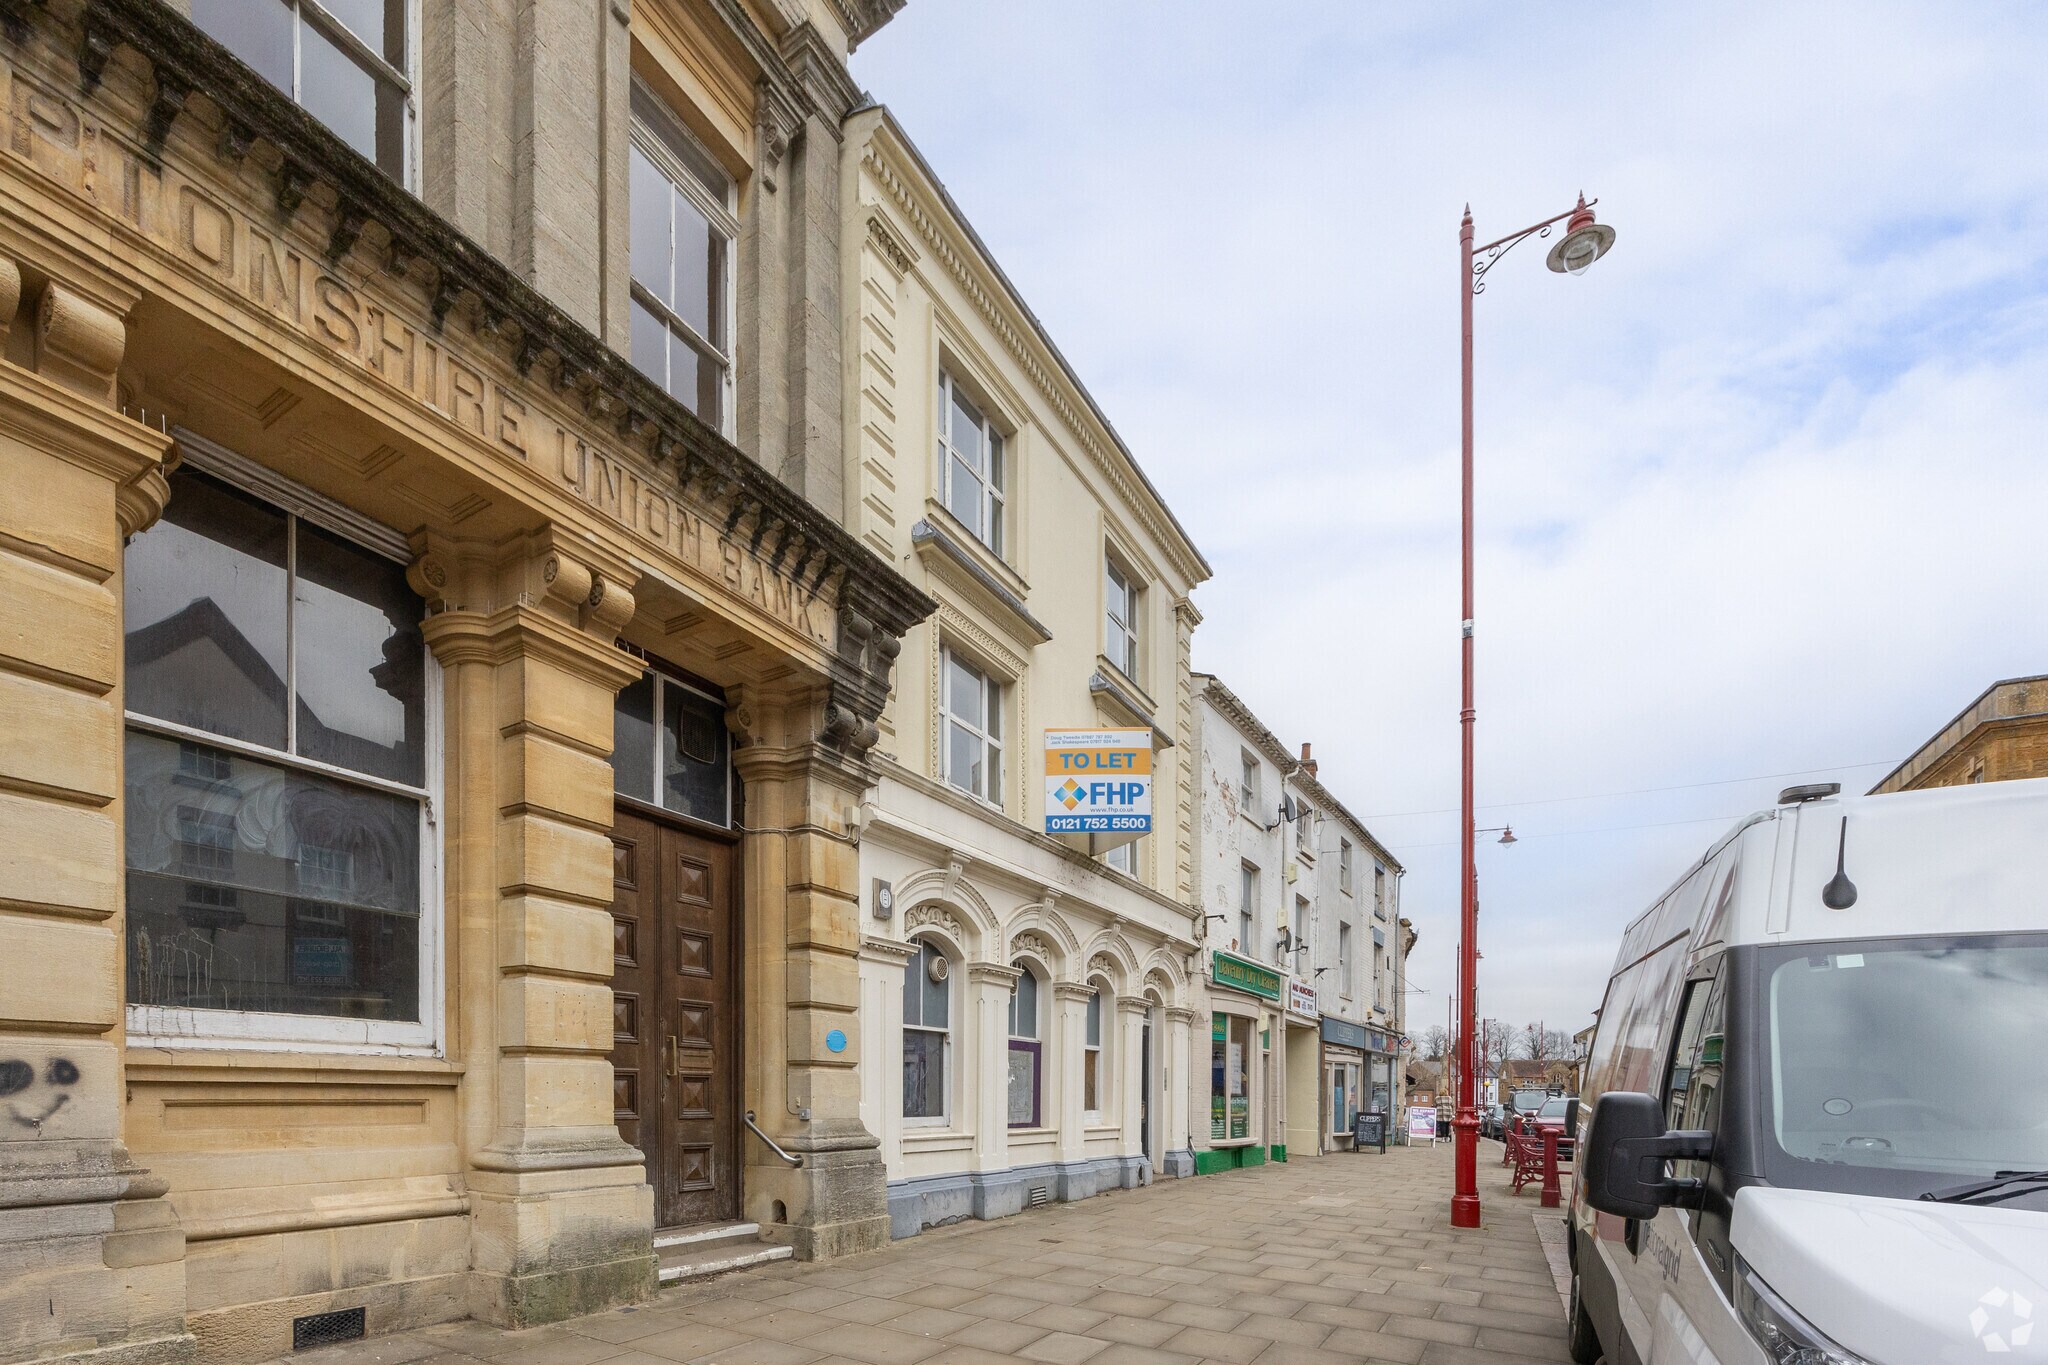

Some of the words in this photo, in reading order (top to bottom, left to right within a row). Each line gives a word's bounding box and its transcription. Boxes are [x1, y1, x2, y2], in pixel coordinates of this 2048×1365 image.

[555, 426, 702, 560] UNION
[1059, 753, 1090, 769] TO
[1095, 752, 1137, 769] LET
[1090, 782, 1145, 805] FHP
[1051, 818, 1081, 830] 0121
[1083, 817, 1108, 829] 752
[1112, 817, 1146, 829] 5500
[1246, 967, 1258, 989] Dry
